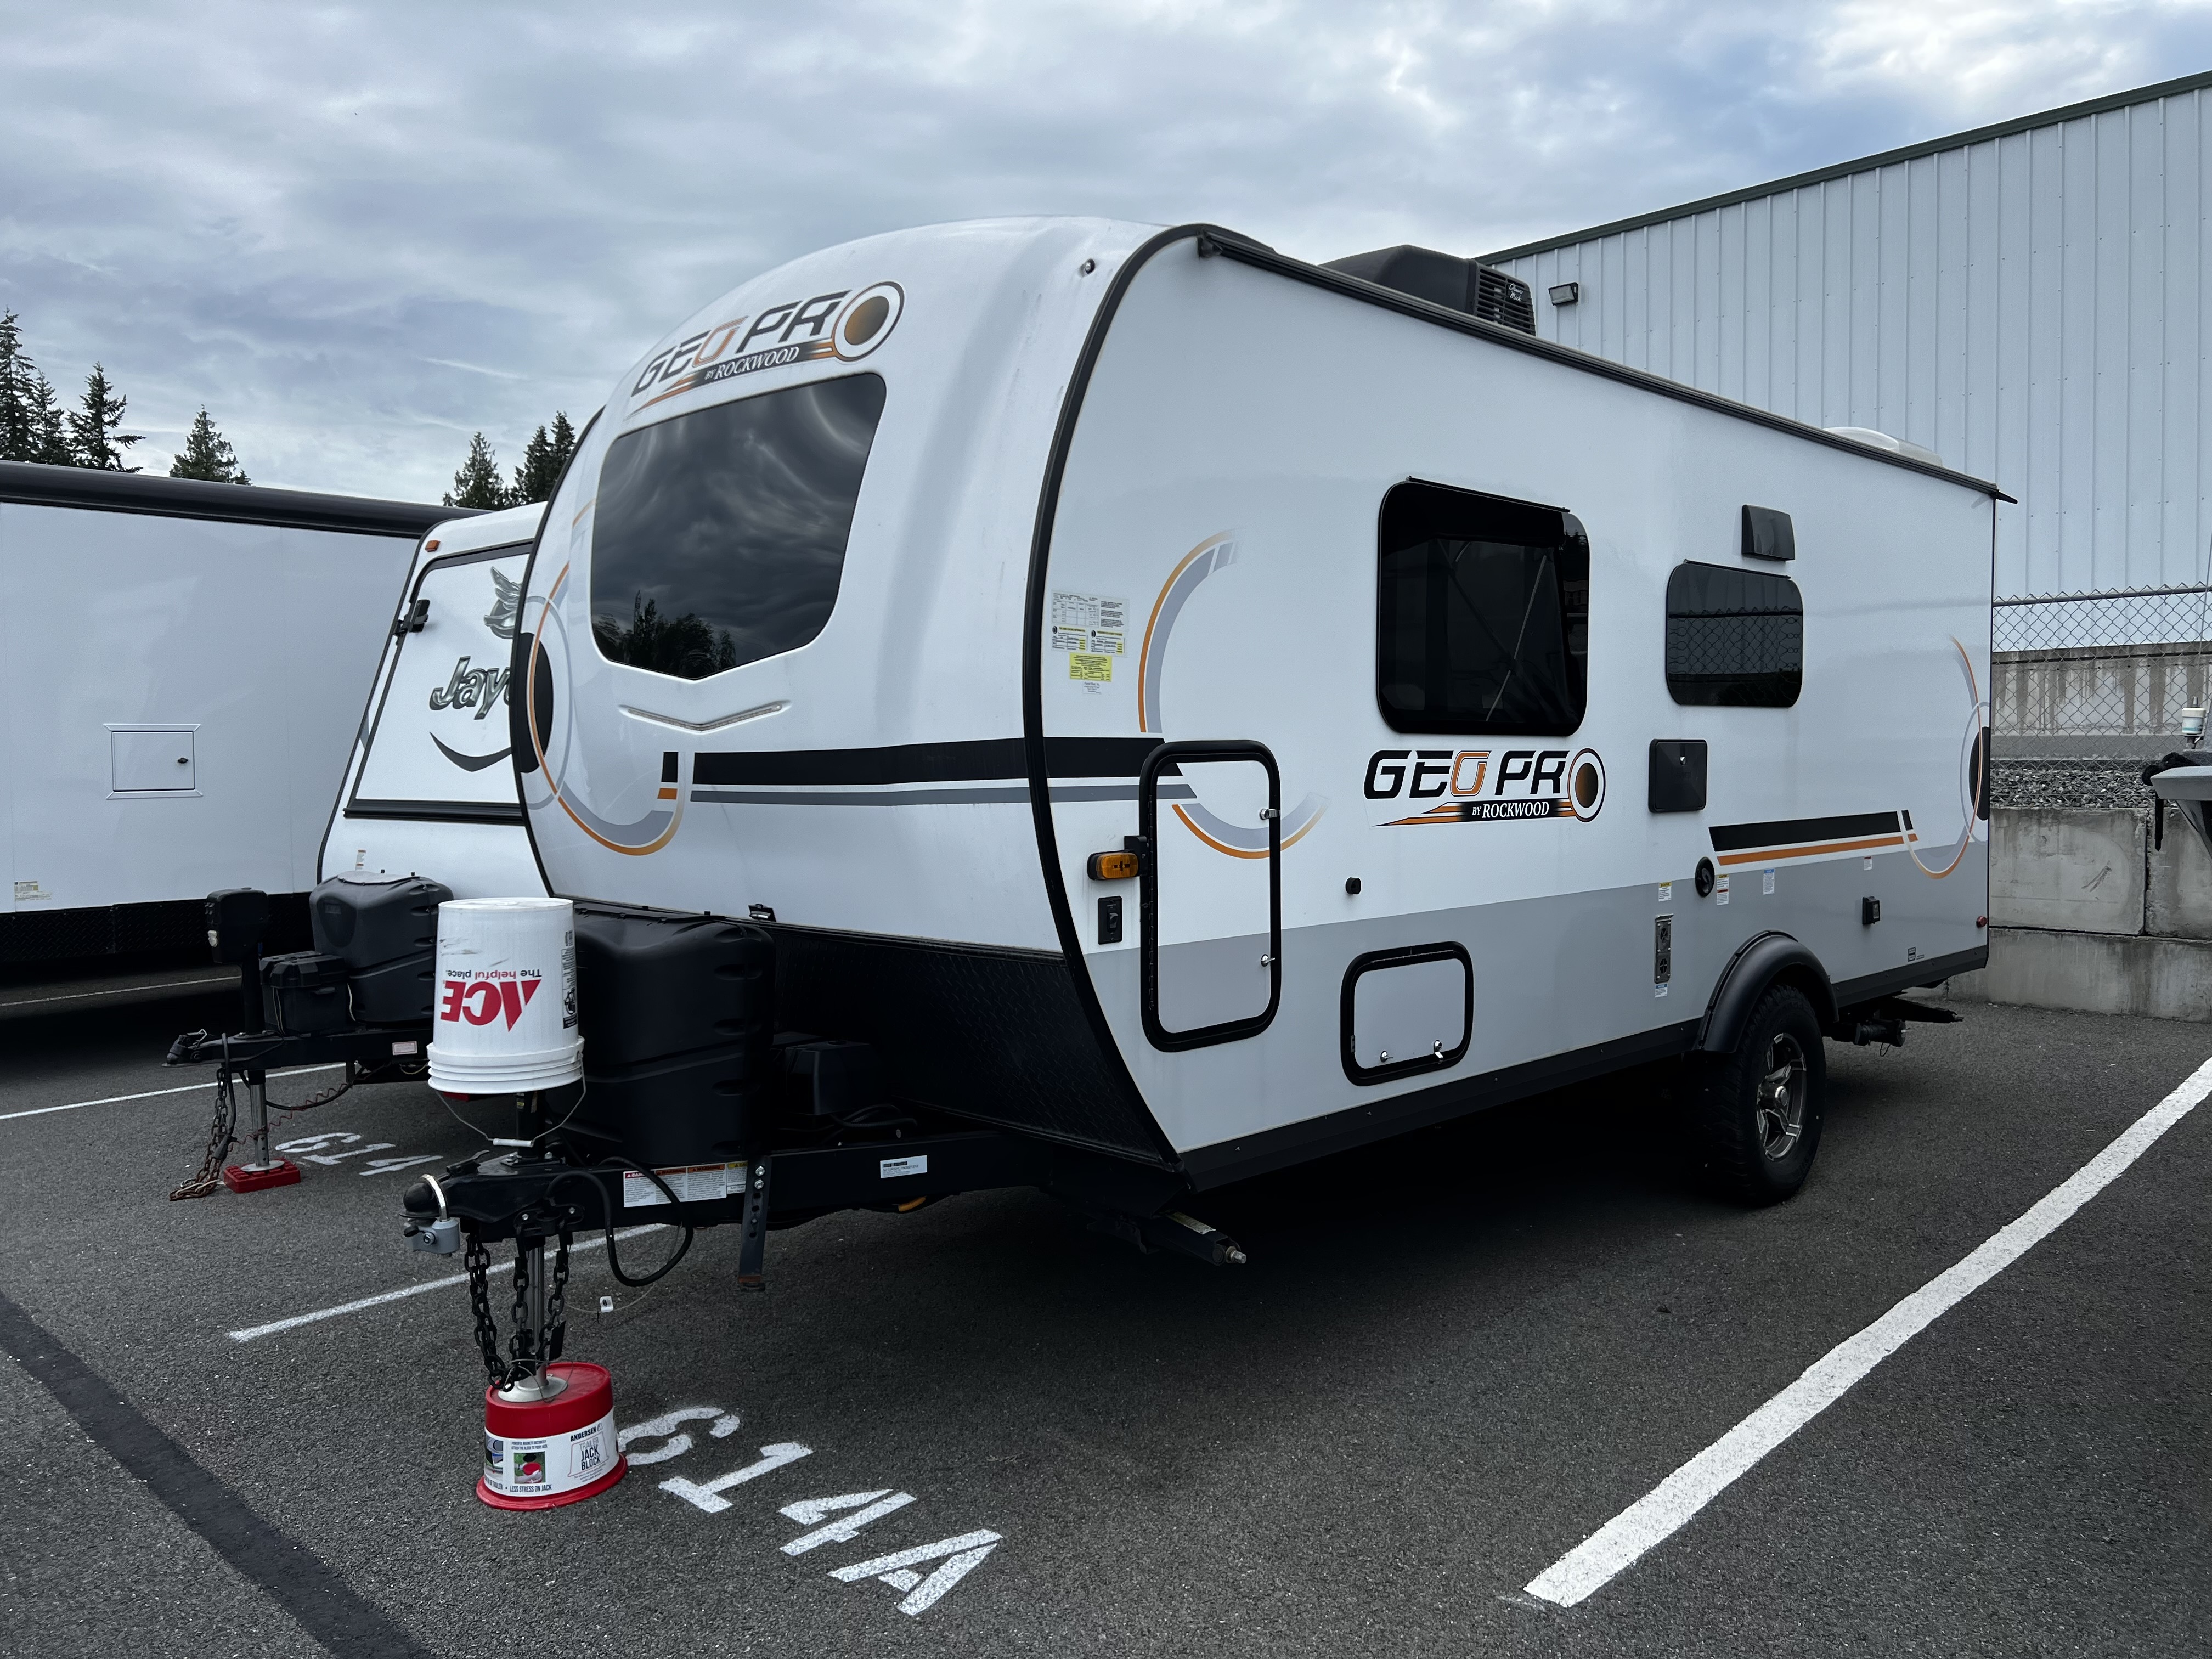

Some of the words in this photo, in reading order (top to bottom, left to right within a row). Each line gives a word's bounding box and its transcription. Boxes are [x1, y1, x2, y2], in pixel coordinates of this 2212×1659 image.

[631, 315, 750, 397] GEO
[735, 280, 905, 363] PRO
[704, 369, 715, 381] BY
[715, 346, 800, 380] ROCKWOOD
[429, 656, 511, 720] Jay
[1363, 750, 1492, 799] GEO
[1494, 747, 1606, 822] PRO
[1471, 806, 1481, 816] BY
[1482, 802, 1549, 819] ROCKWOOD
[475, 969, 516, 980] helpful
[520, 969, 542, 978] The
[440, 979, 542, 1032] ACE
[570, 1426, 596, 1442] ANDERSEN
[579, 1436, 599, 1451] TRAILER
[581, 1444, 599, 1462] JACK
[581, 1454, 601, 1471] BLOCK
